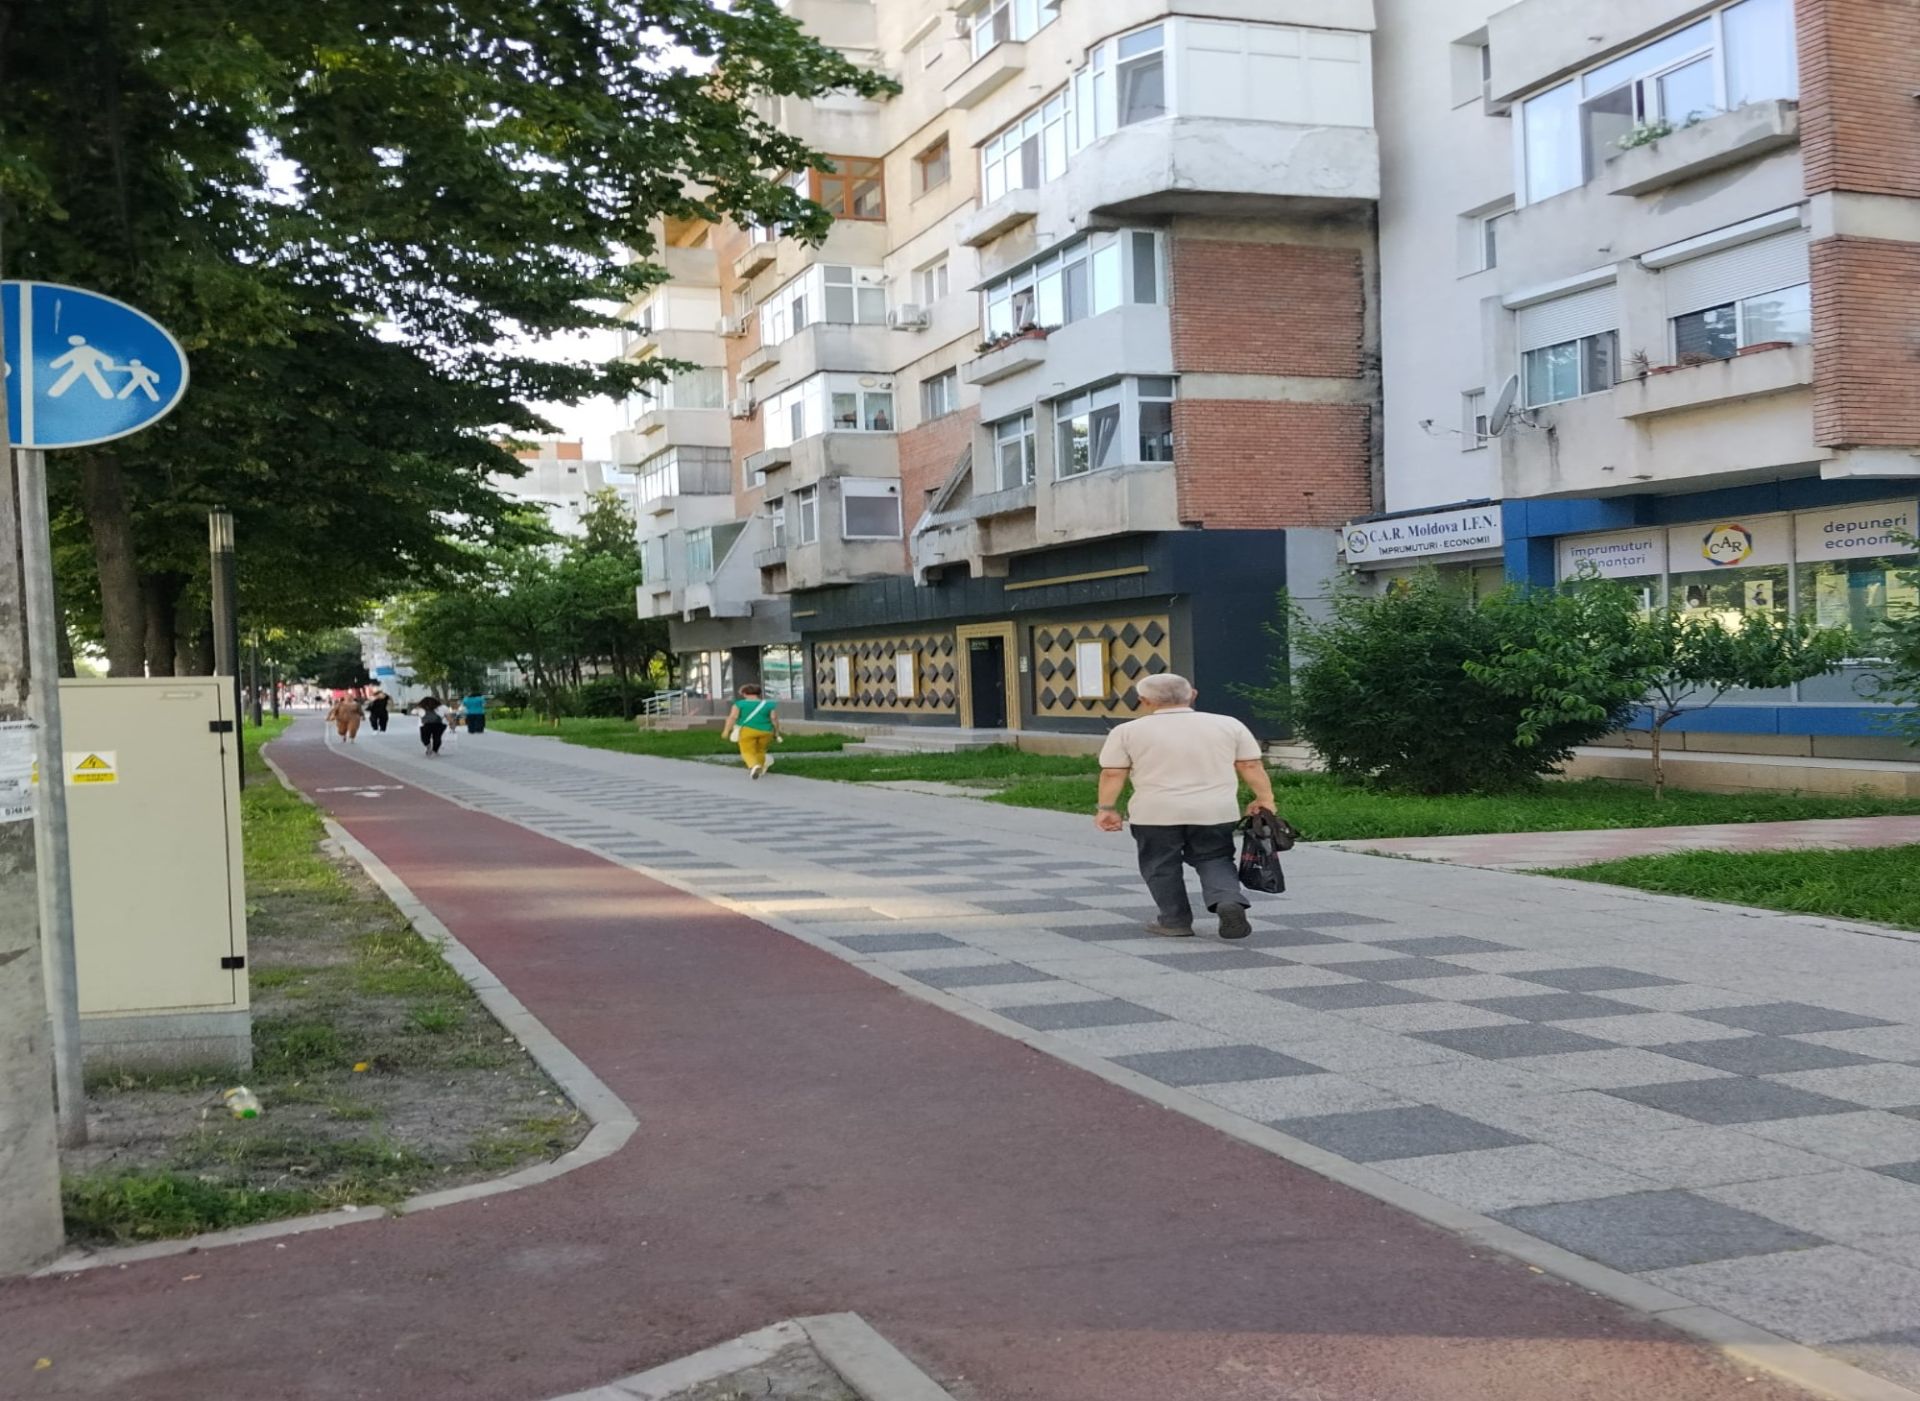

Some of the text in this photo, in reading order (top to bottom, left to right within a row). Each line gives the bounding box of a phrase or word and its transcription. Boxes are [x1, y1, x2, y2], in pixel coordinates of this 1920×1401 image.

[1369, 528, 1405, 543] C.A.R.
[1408, 522, 1458, 537] Moldova
[1462, 514, 1497, 532] I.F.N.
[1823, 513, 1907, 534] depuneri
[1443, 535, 1490, 549] ECONOMII
[1710, 536, 1742, 554] CAR
[1825, 534, 1905, 549] econom
